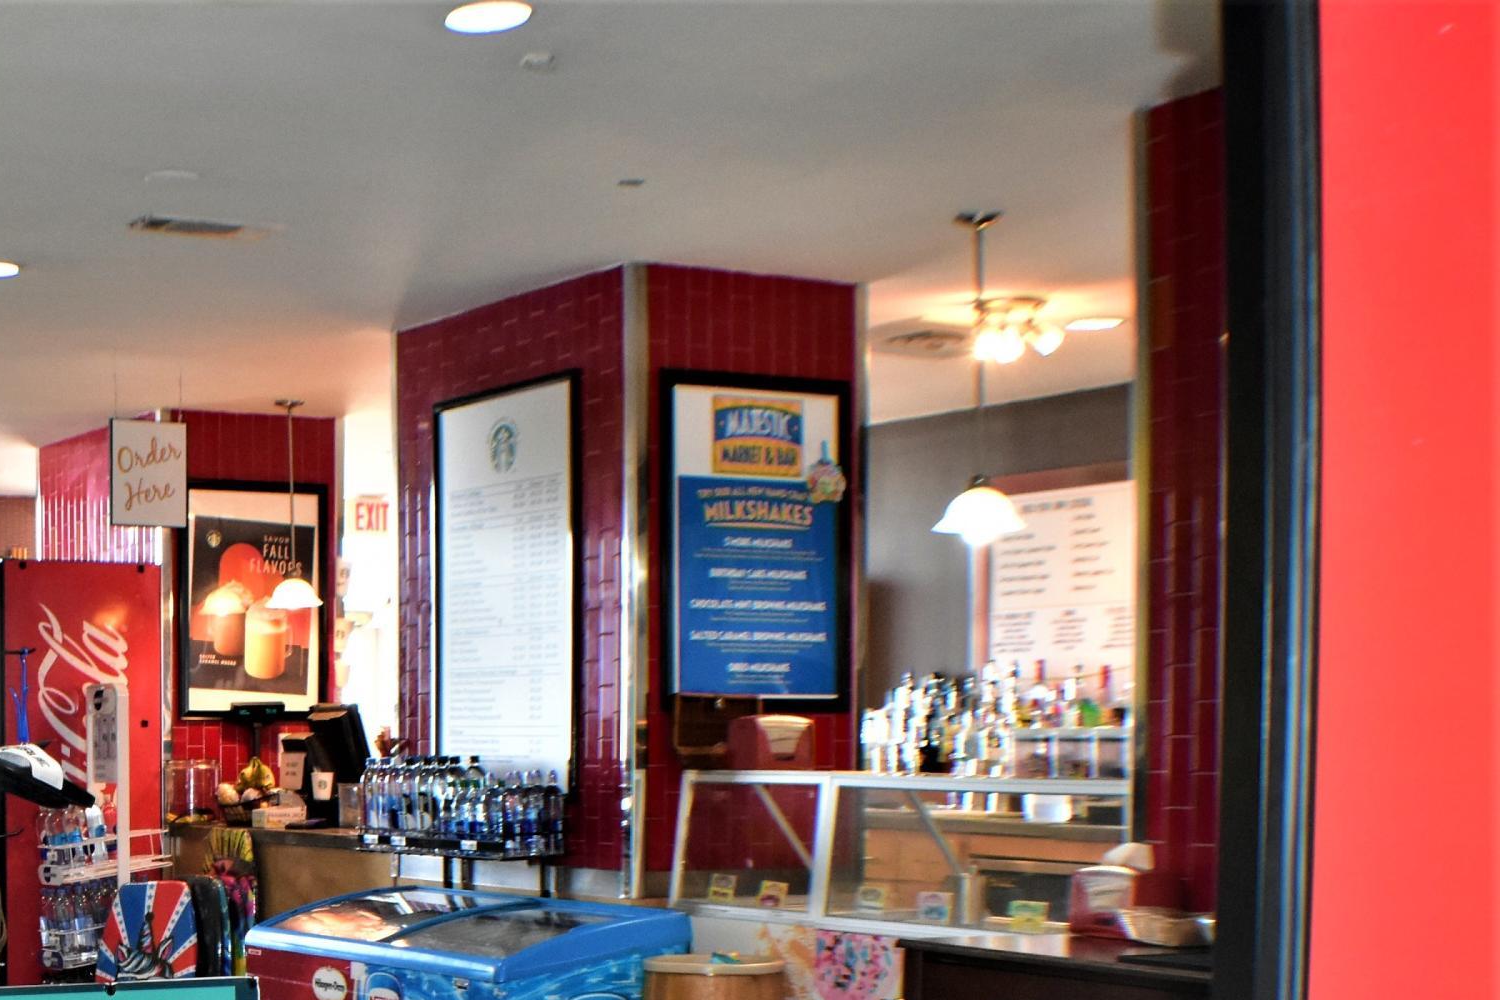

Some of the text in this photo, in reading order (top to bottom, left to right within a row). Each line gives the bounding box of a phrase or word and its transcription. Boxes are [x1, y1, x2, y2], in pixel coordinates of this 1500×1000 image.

[117, 436, 181, 473] Order
[124, 477, 175, 511] Here
[355, 502, 389, 531] EXIT
[704, 500, 813, 526] MILKSHAKES
[263, 543, 289, 560] FALL
